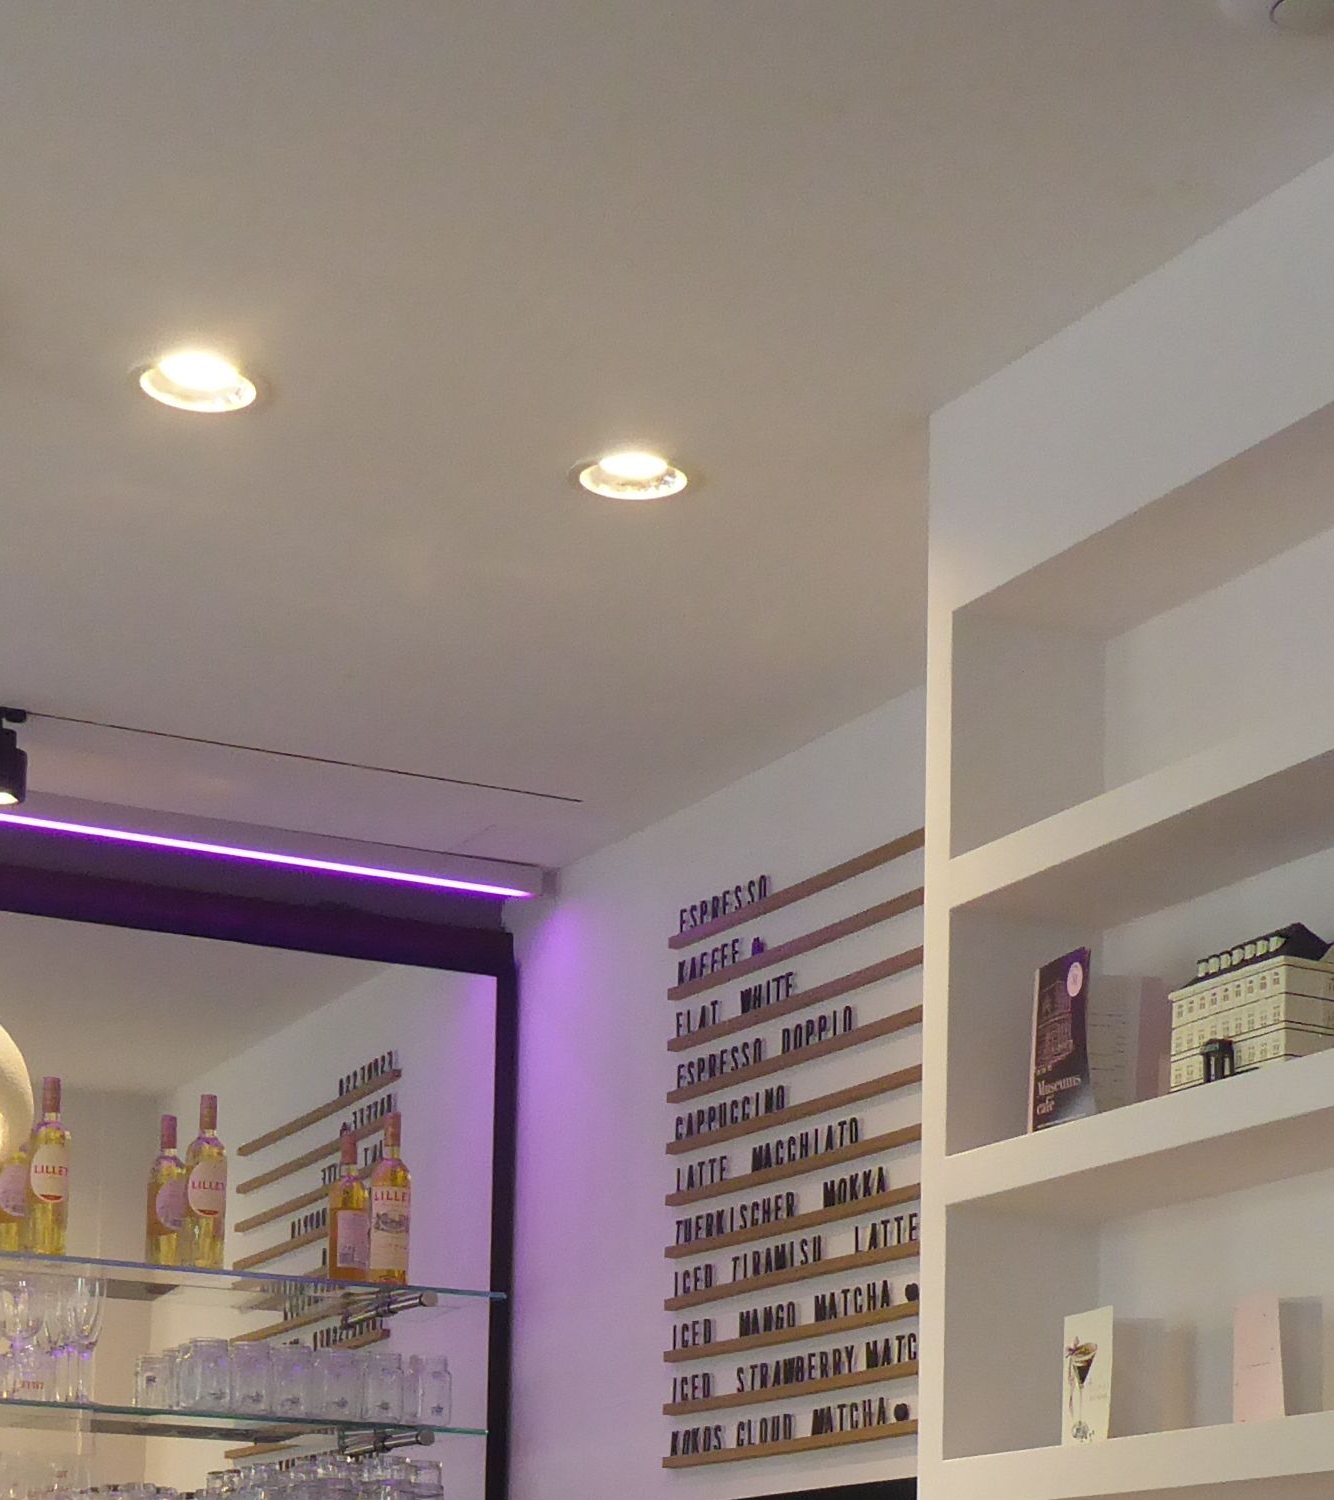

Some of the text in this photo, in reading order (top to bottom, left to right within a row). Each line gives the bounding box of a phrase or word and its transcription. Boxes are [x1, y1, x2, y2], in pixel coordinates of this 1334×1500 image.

[679, 874, 767, 933] ESPRESSO
[677, 938, 739, 986] KAFFEE
[676, 971, 794, 1038] FLAT WHITE
[677, 1005, 854, 1089] ESPRESSO DOPPIO
[675, 1084, 785, 1141] CAPPUCCINO
[676, 1117, 859, 1193] LATTE MACCHIATO
[675, 1166, 886, 1245] TUERKISCHER MOKKA
[674, 1212, 918, 1298] ICED TIRAMISU LATTE
[673, 1279, 890, 1351] ICED MANGO MATCHA
[673, 1332, 917, 1404] ICED STRAWBERRY MATC
[670, 1397, 886, 1457] KOKOS CLOUD MATCHA
